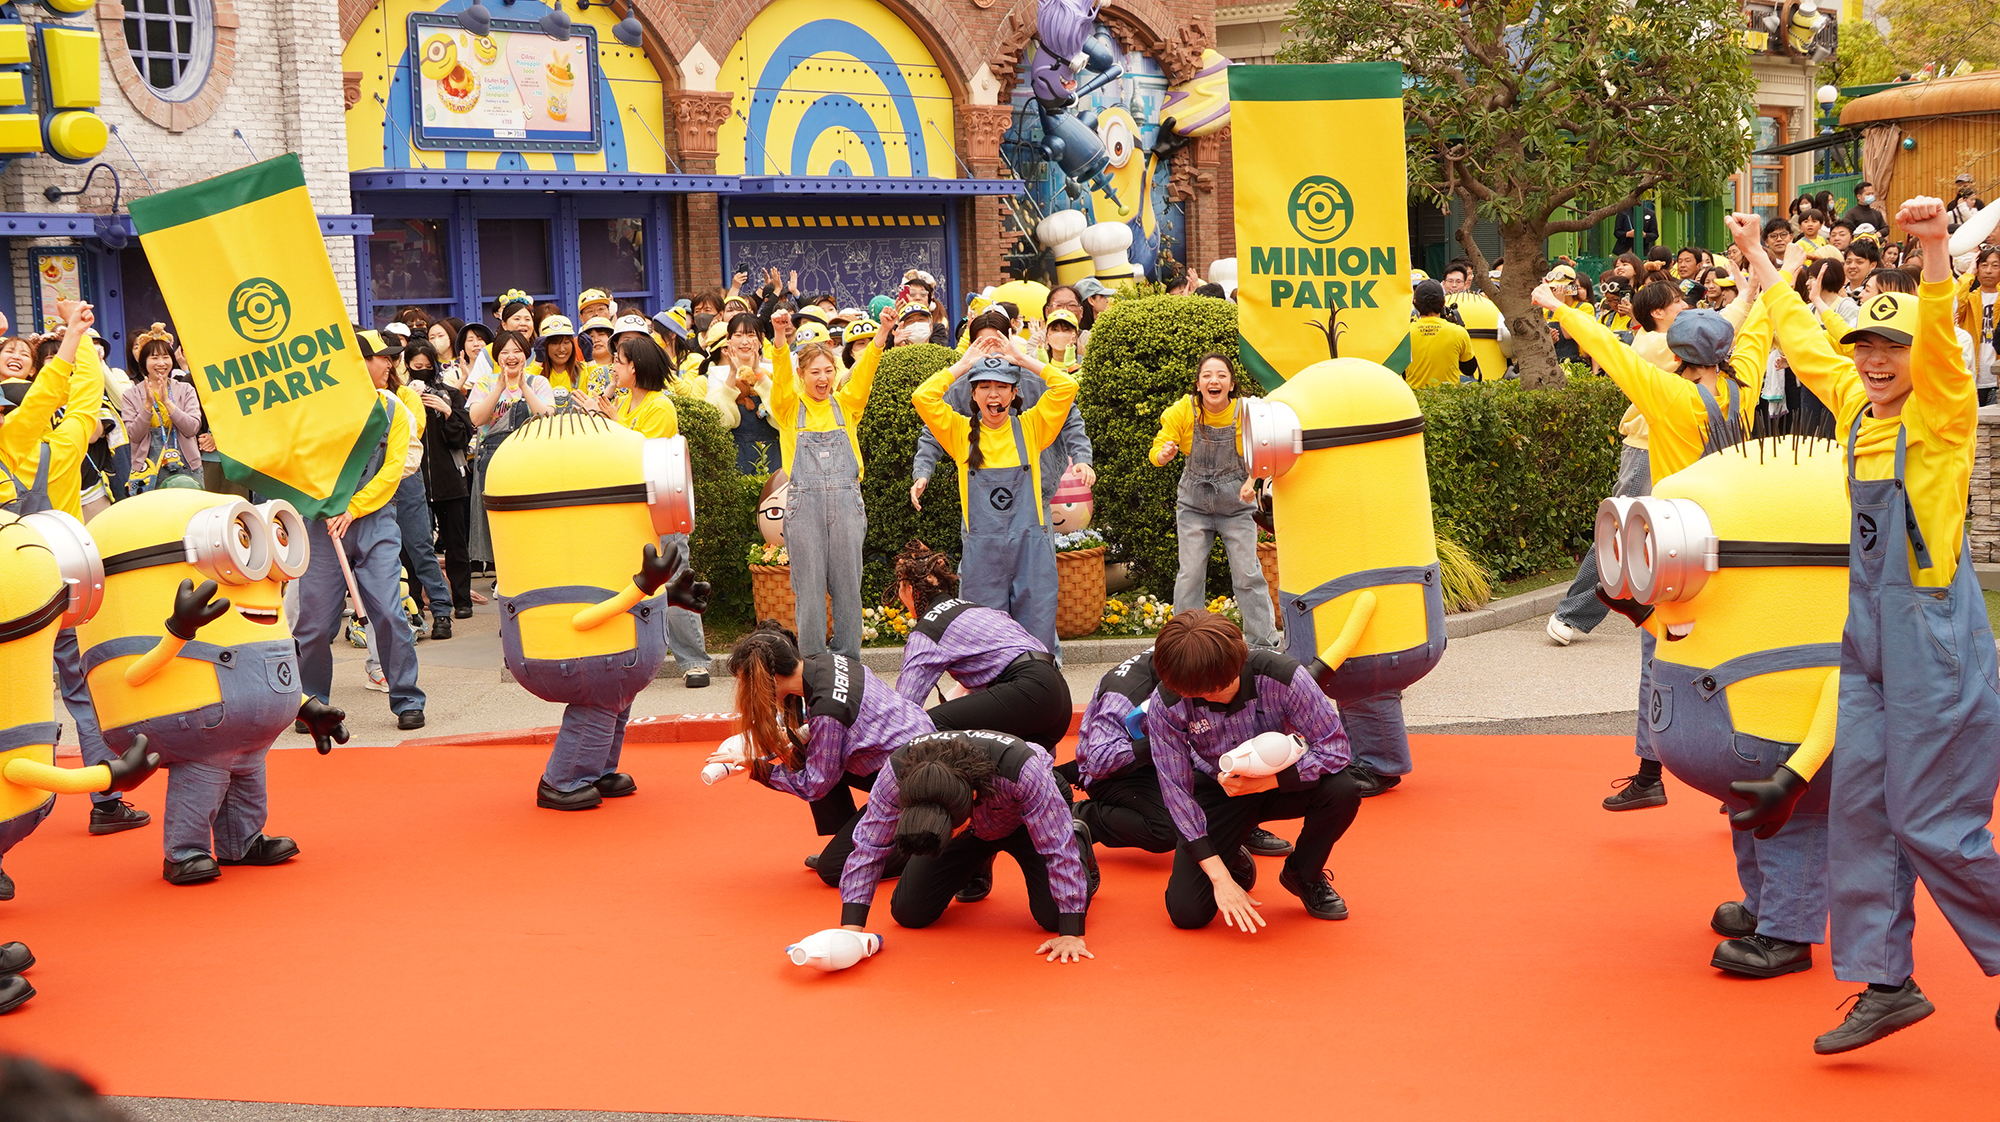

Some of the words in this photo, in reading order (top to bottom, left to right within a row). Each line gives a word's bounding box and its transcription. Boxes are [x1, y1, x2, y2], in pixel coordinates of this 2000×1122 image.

[1250, 246, 1397, 276] MINION
[1270, 280, 1379, 309] PARK
[203, 323, 346, 393] MINION
[235, 358, 340, 416] PARK
[924, 598, 960, 622] EVENT
[832, 653, 849, 672] STA
[832, 668, 850, 704] EVENT
[680, 712, 744, 720] STO
